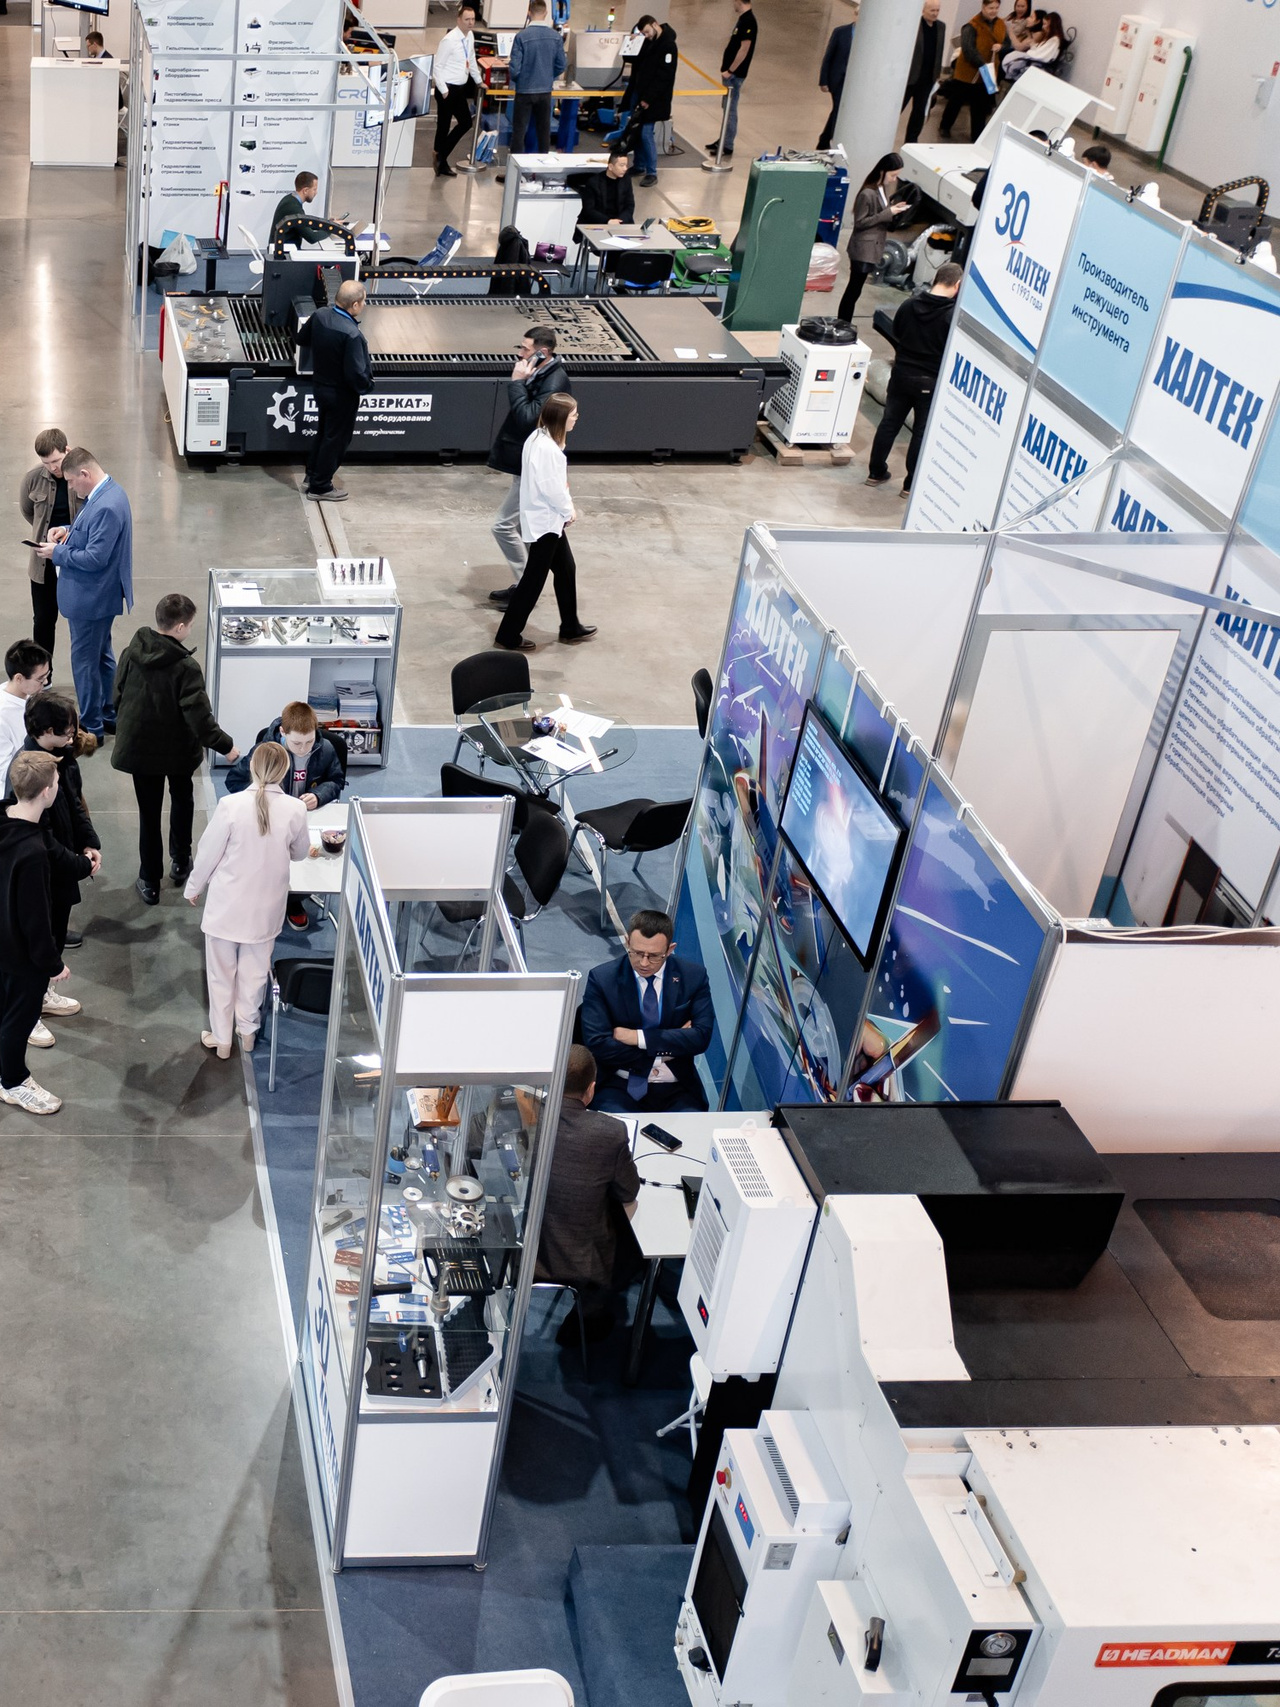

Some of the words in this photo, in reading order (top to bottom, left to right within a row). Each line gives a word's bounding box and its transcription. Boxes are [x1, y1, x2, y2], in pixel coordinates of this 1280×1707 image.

[994, 183, 1030, 242] 30
[1006, 246, 1051, 297] ХАЛТЕК
[1078, 252, 1149, 312] Производитель
[1016, 284, 1030, 301] 1993
[1029, 295, 1043, 311] года
[1083, 286, 1129, 325] режущего
[1072, 304, 1130, 353] инструмента
[359, 398, 430, 409] АЗЕРКАТ»
[949, 352, 1008, 426] ХАЛТЕК
[1153, 335, 1264, 451] ХАЛТЕК
[372, 414, 432, 422] оборудование
[1110, 488, 1174, 532] ХАЛТ
[355, 878, 385, 1027] ХАЛТЕК
[1121, 1648, 1229, 1661] HEADMAN
